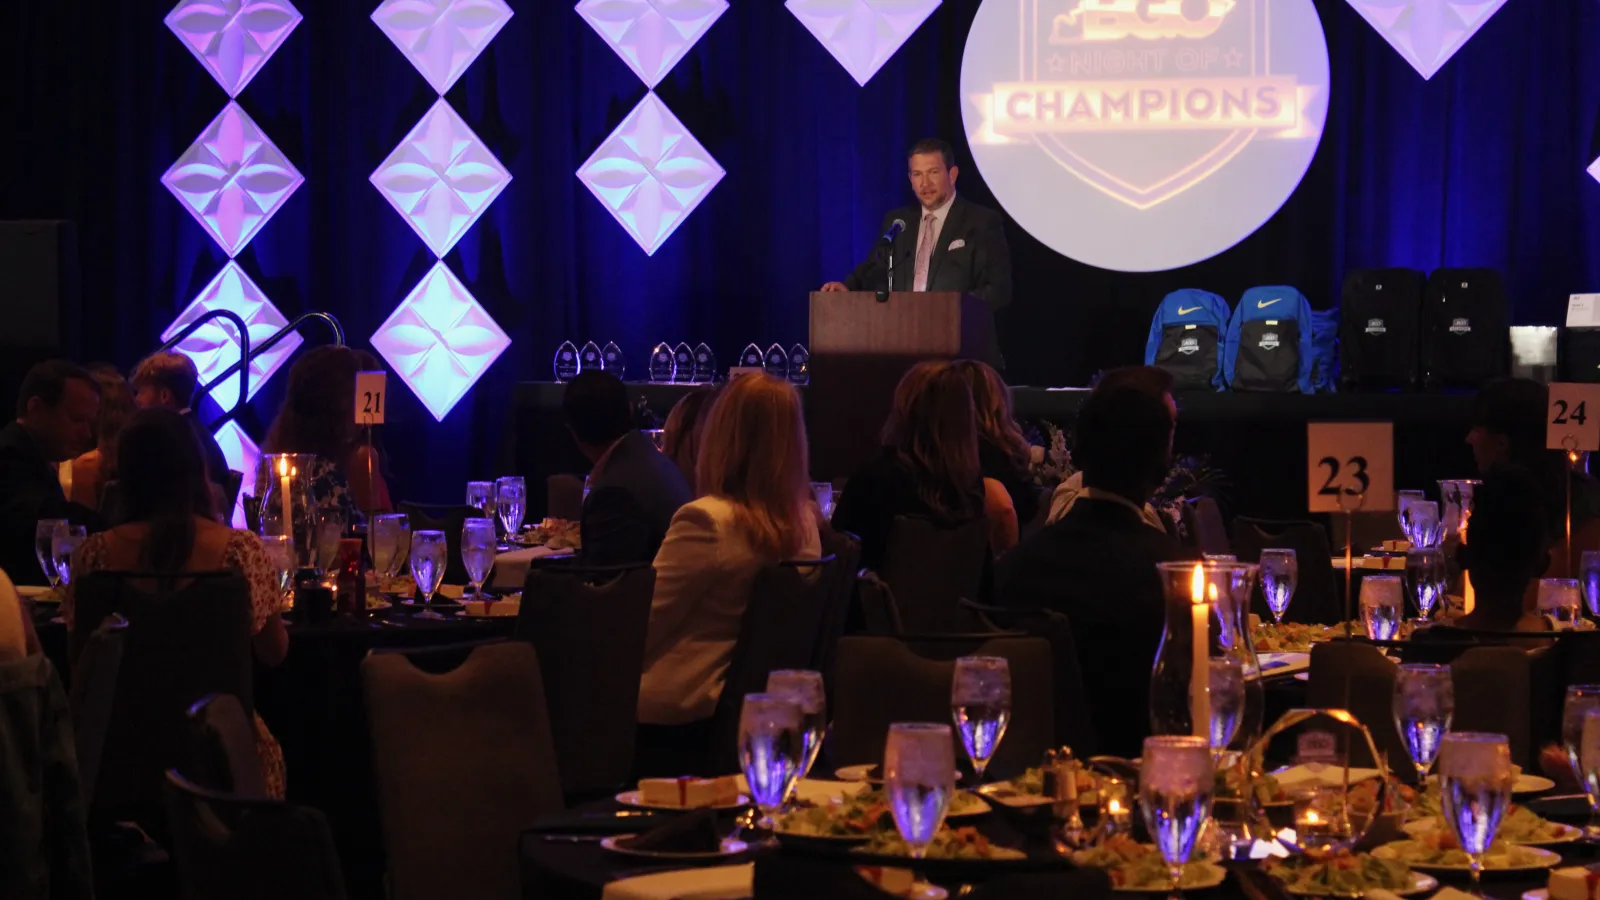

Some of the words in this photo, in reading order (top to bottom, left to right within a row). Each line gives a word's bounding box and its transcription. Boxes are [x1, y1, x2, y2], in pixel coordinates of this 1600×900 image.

[1069, 48, 1168, 75] NIGHT
[1174, 46, 1219, 72] OF
[1005, 85, 1283, 122] CHAMPIONS
[363, 391, 381, 414] 21
[1551, 399, 1587, 425] 24
[1317, 456, 1370, 496] 23
